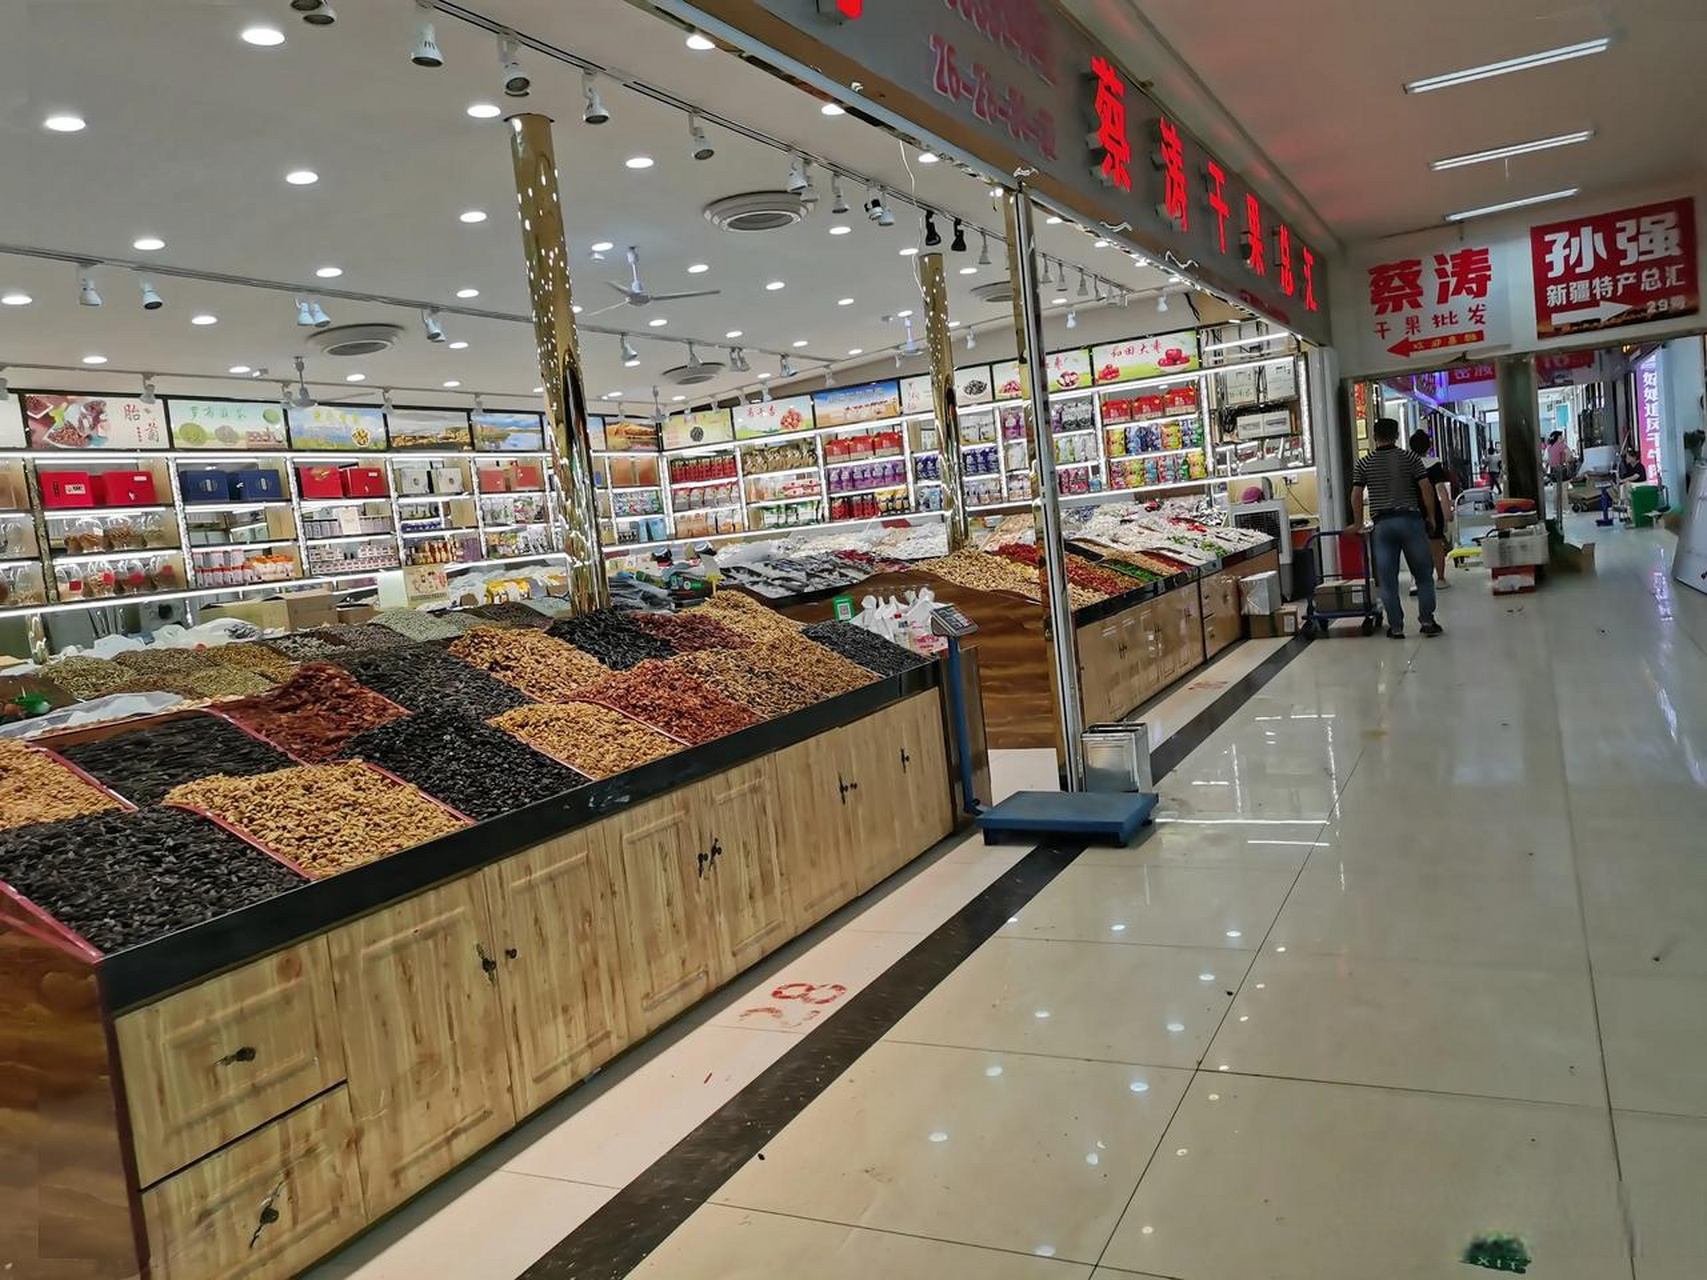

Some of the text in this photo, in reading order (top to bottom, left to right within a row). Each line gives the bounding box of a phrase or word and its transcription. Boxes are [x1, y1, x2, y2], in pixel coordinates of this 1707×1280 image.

[1543, 210, 1684, 278] 孙强
[1367, 246, 1492, 316] 蔡涛
[1546, 264, 1687, 308] 新疆特产总汇
[1373, 302, 1487, 340] 干果批发
